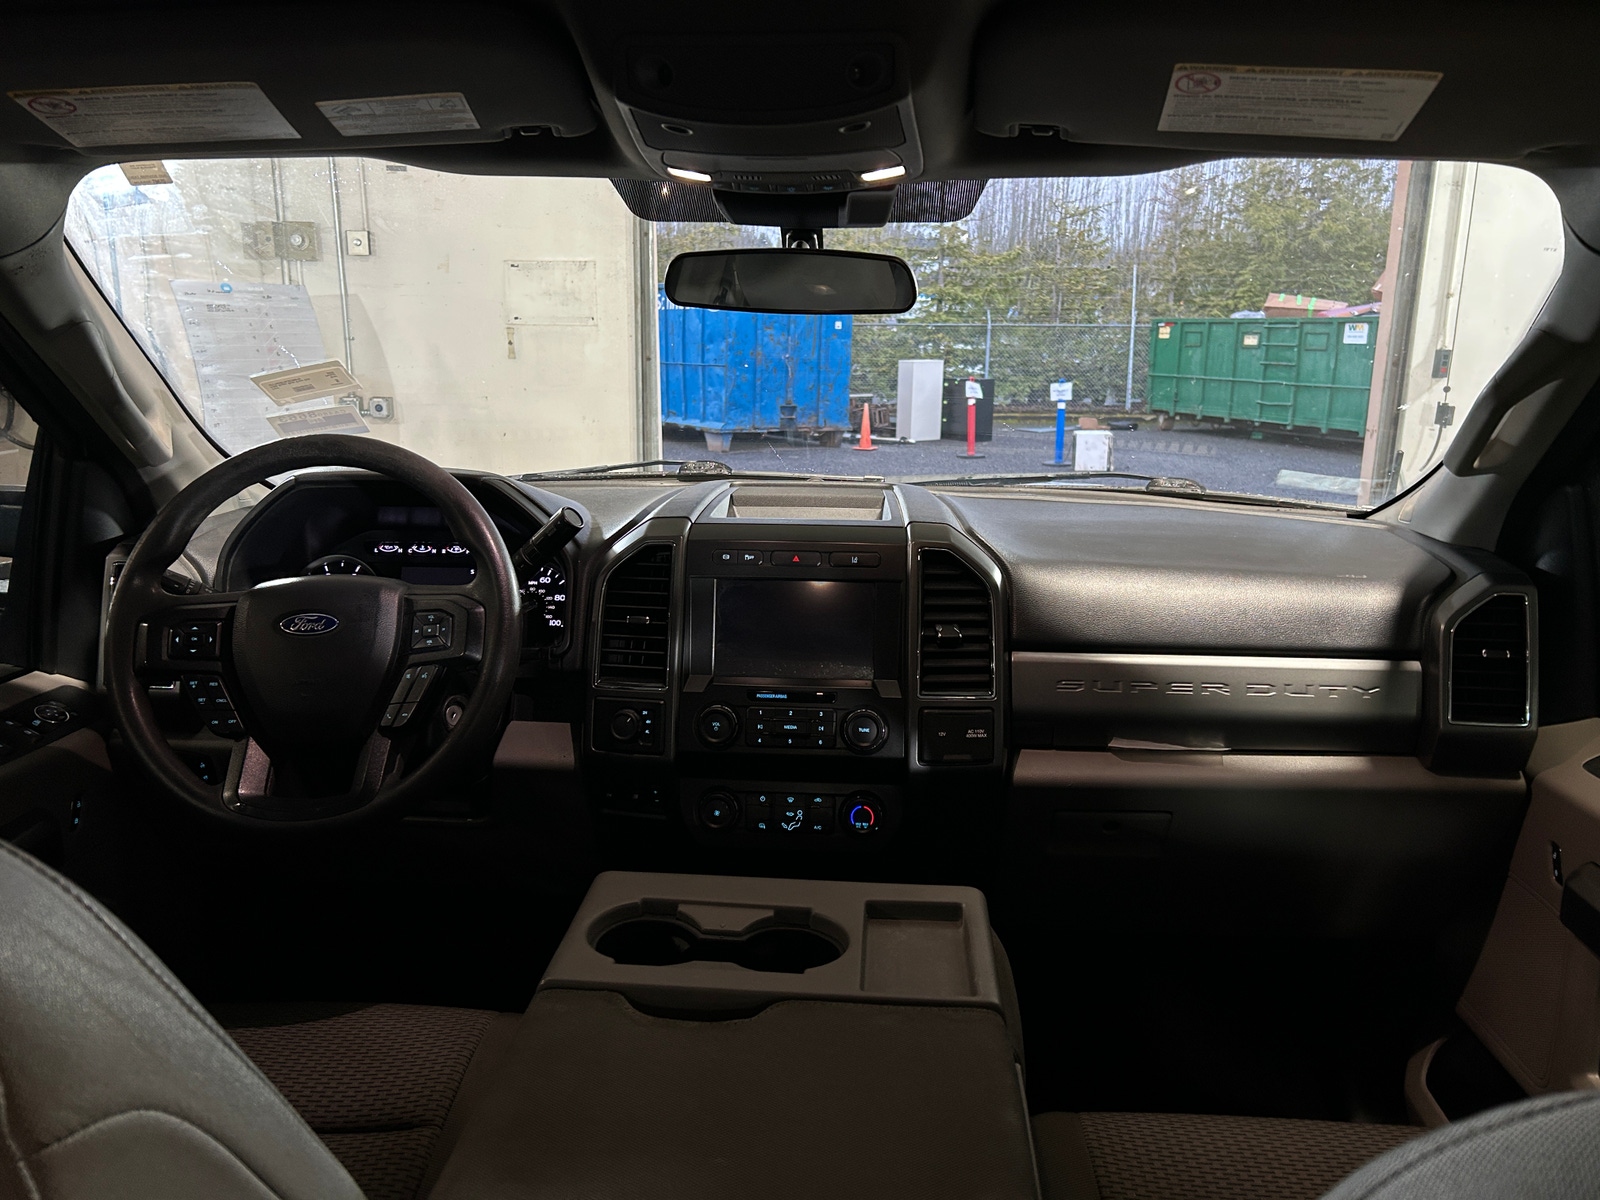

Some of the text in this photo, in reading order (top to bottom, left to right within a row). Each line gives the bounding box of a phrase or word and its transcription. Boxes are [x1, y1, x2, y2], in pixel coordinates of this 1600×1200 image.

[539, 576, 551, 584] 60
[1056, 680, 1380, 699] SUPER DUTY
